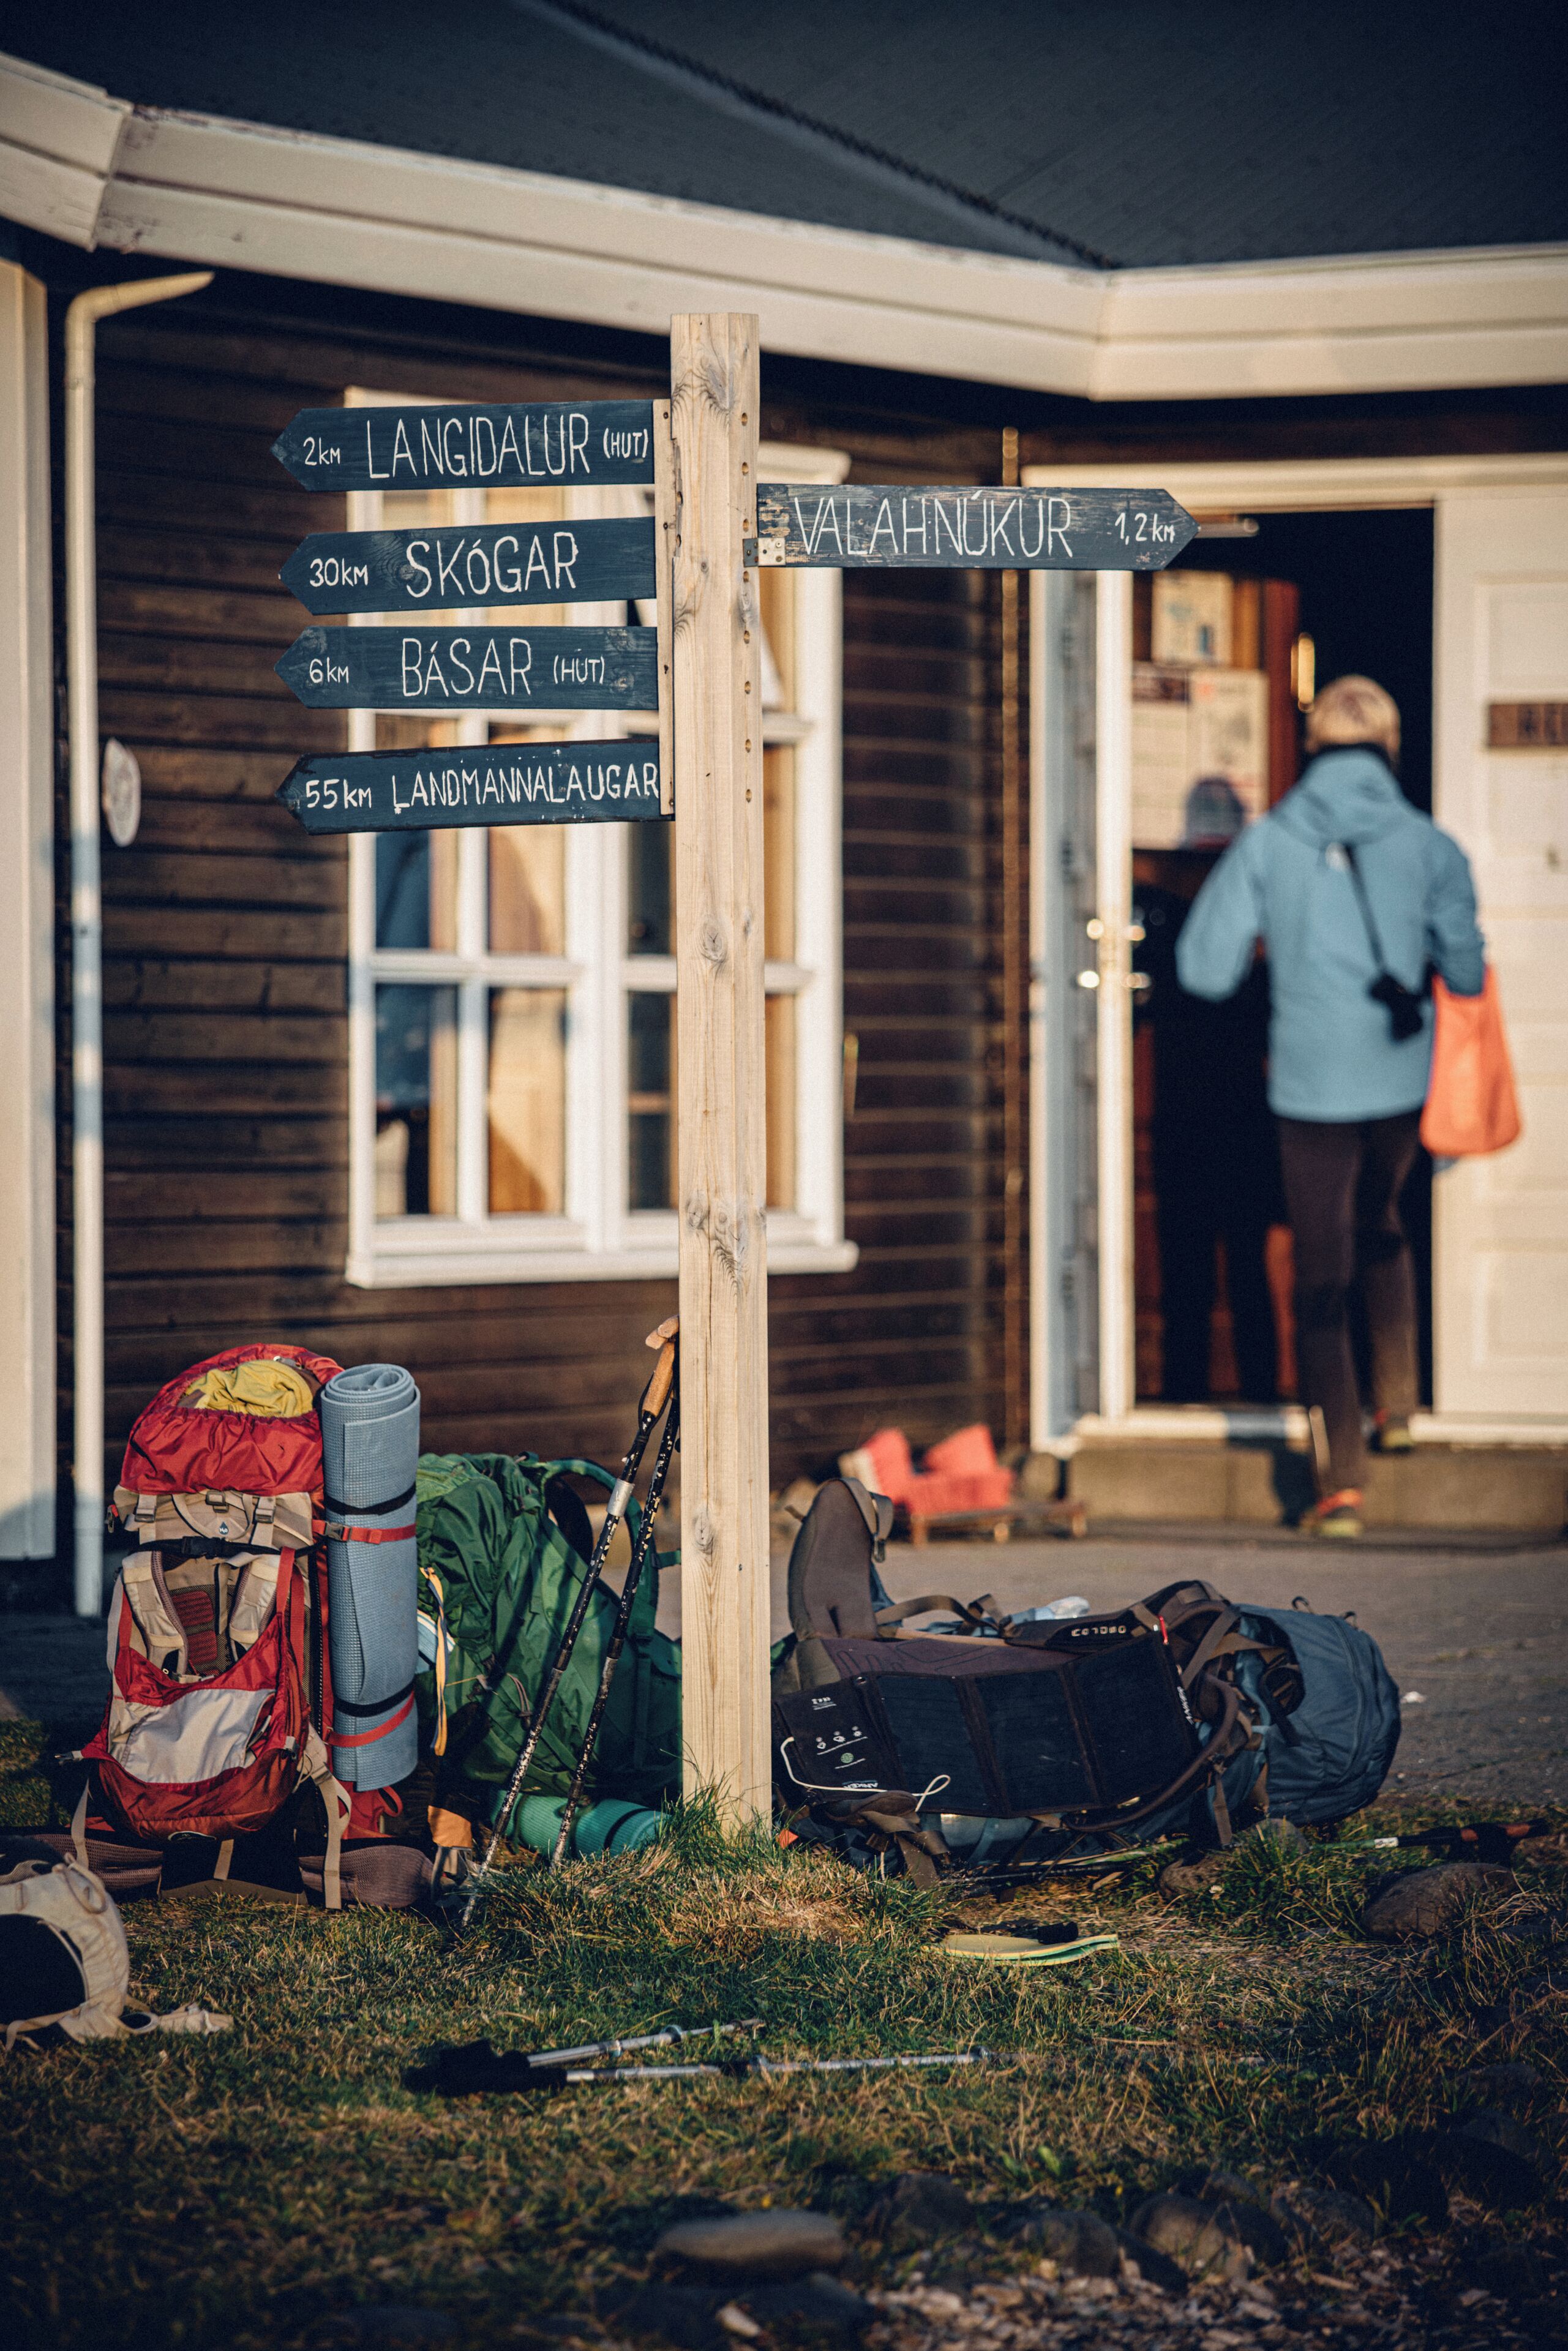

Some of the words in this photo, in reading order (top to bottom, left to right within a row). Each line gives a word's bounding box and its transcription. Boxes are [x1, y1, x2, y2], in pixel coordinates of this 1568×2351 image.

[367, 413, 590, 479] LANGIDALUR
[603, 427, 648, 459] (HUT)
[794, 490, 1073, 558] VALAHNÚKUR
[406, 531, 579, 598] SKÓGAR
[402, 637, 531, 697] BÁSAR
[553, 655, 605, 684] (HUT)
[392, 762, 659, 808] LANDMANNALAUGAR
